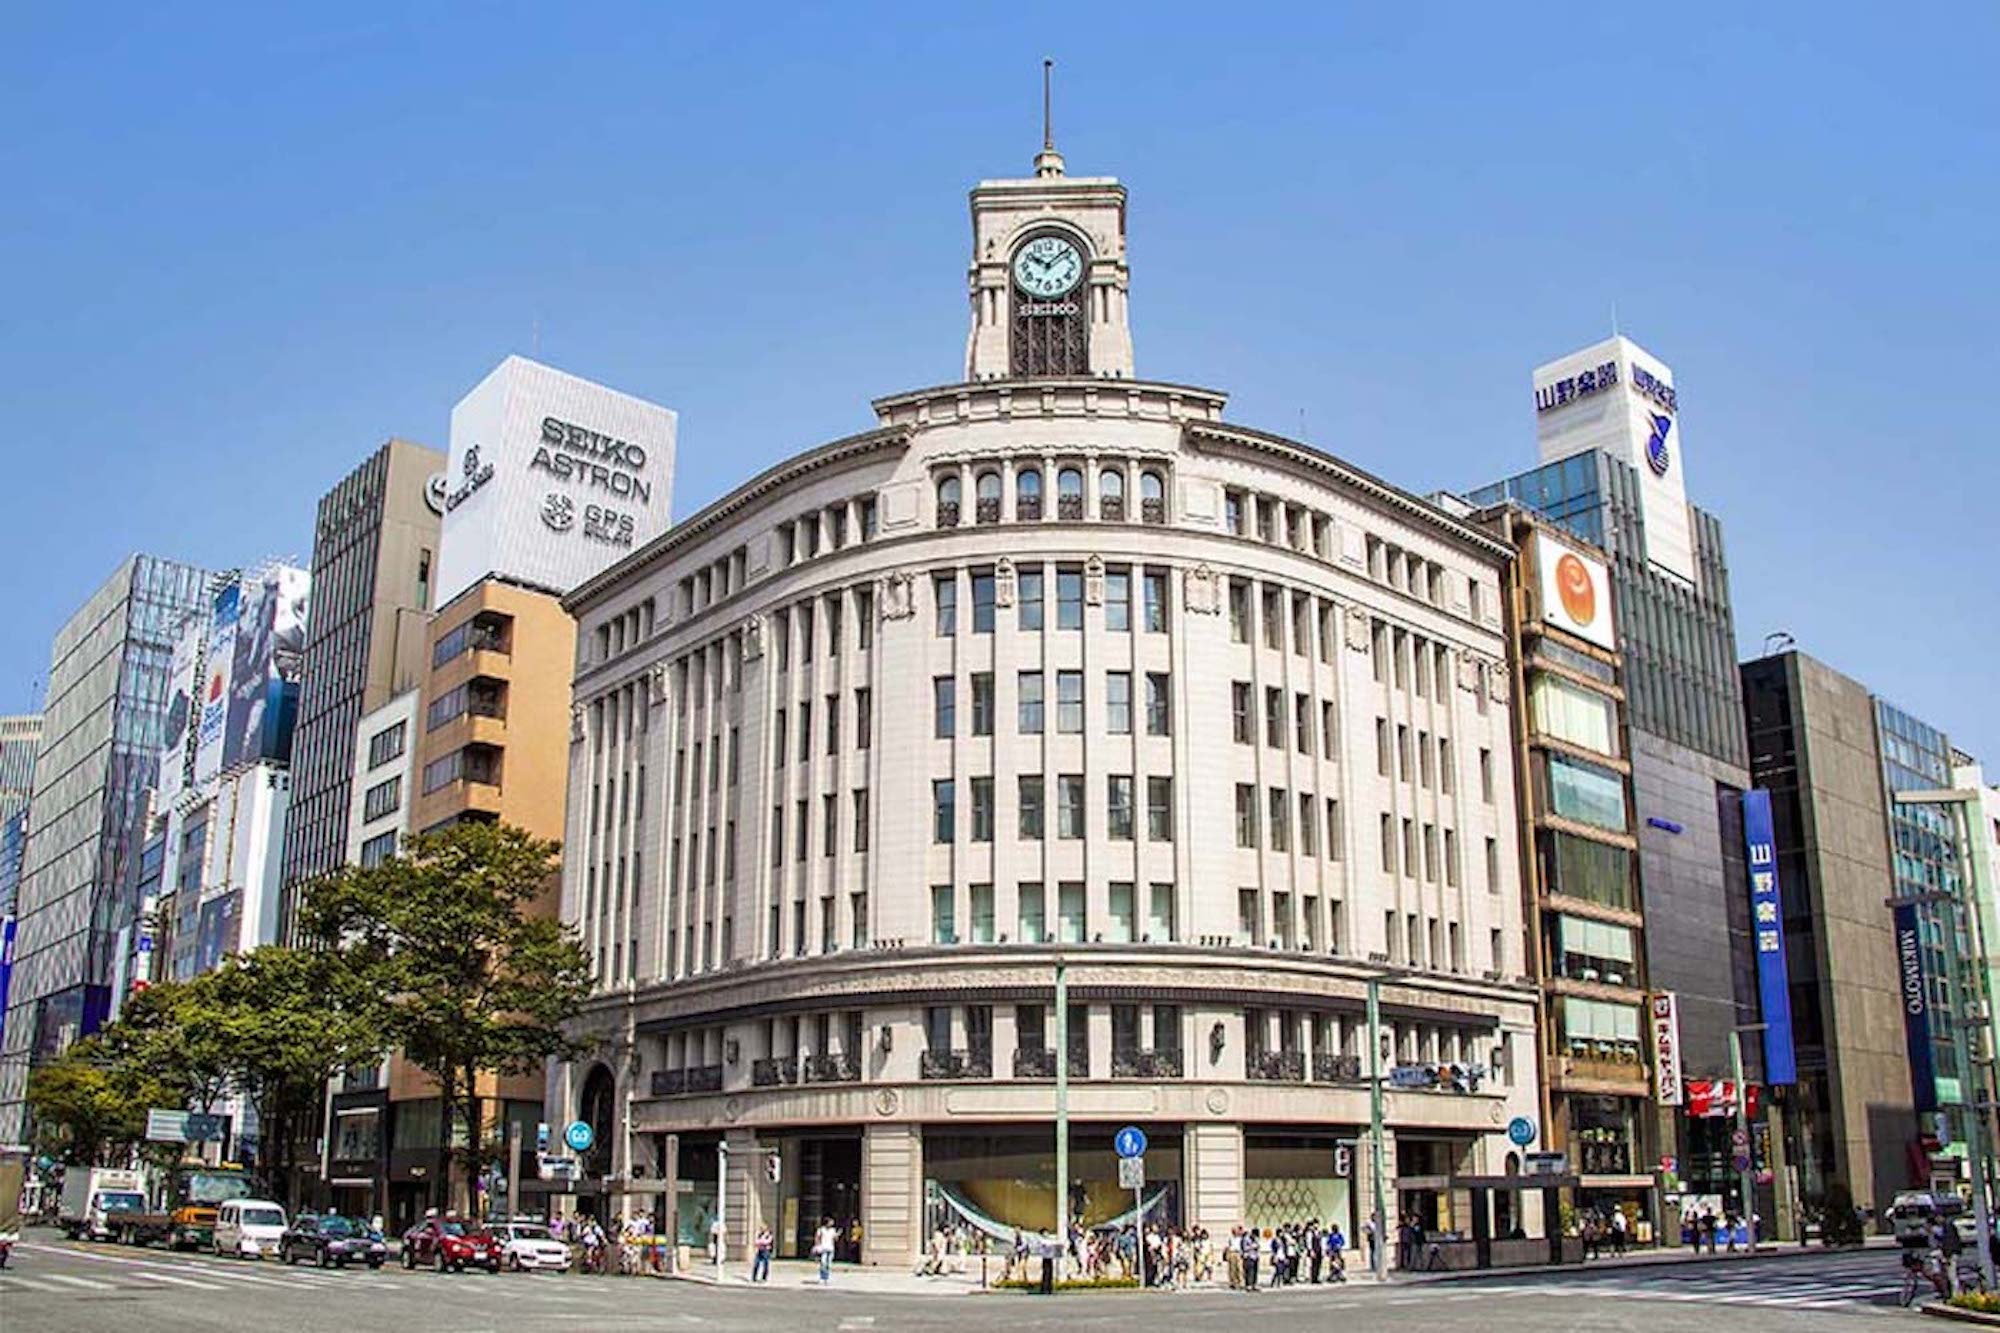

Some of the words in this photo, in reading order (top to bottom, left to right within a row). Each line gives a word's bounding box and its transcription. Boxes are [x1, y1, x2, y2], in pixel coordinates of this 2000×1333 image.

[1019, 303, 1079, 316] SEIKO
[542, 417, 646, 471] SEIKO
[531, 447, 651, 504] ASTRON
[585, 504, 634, 532] GPS
[1900, 929, 1924, 1015] MIKIMOTO
